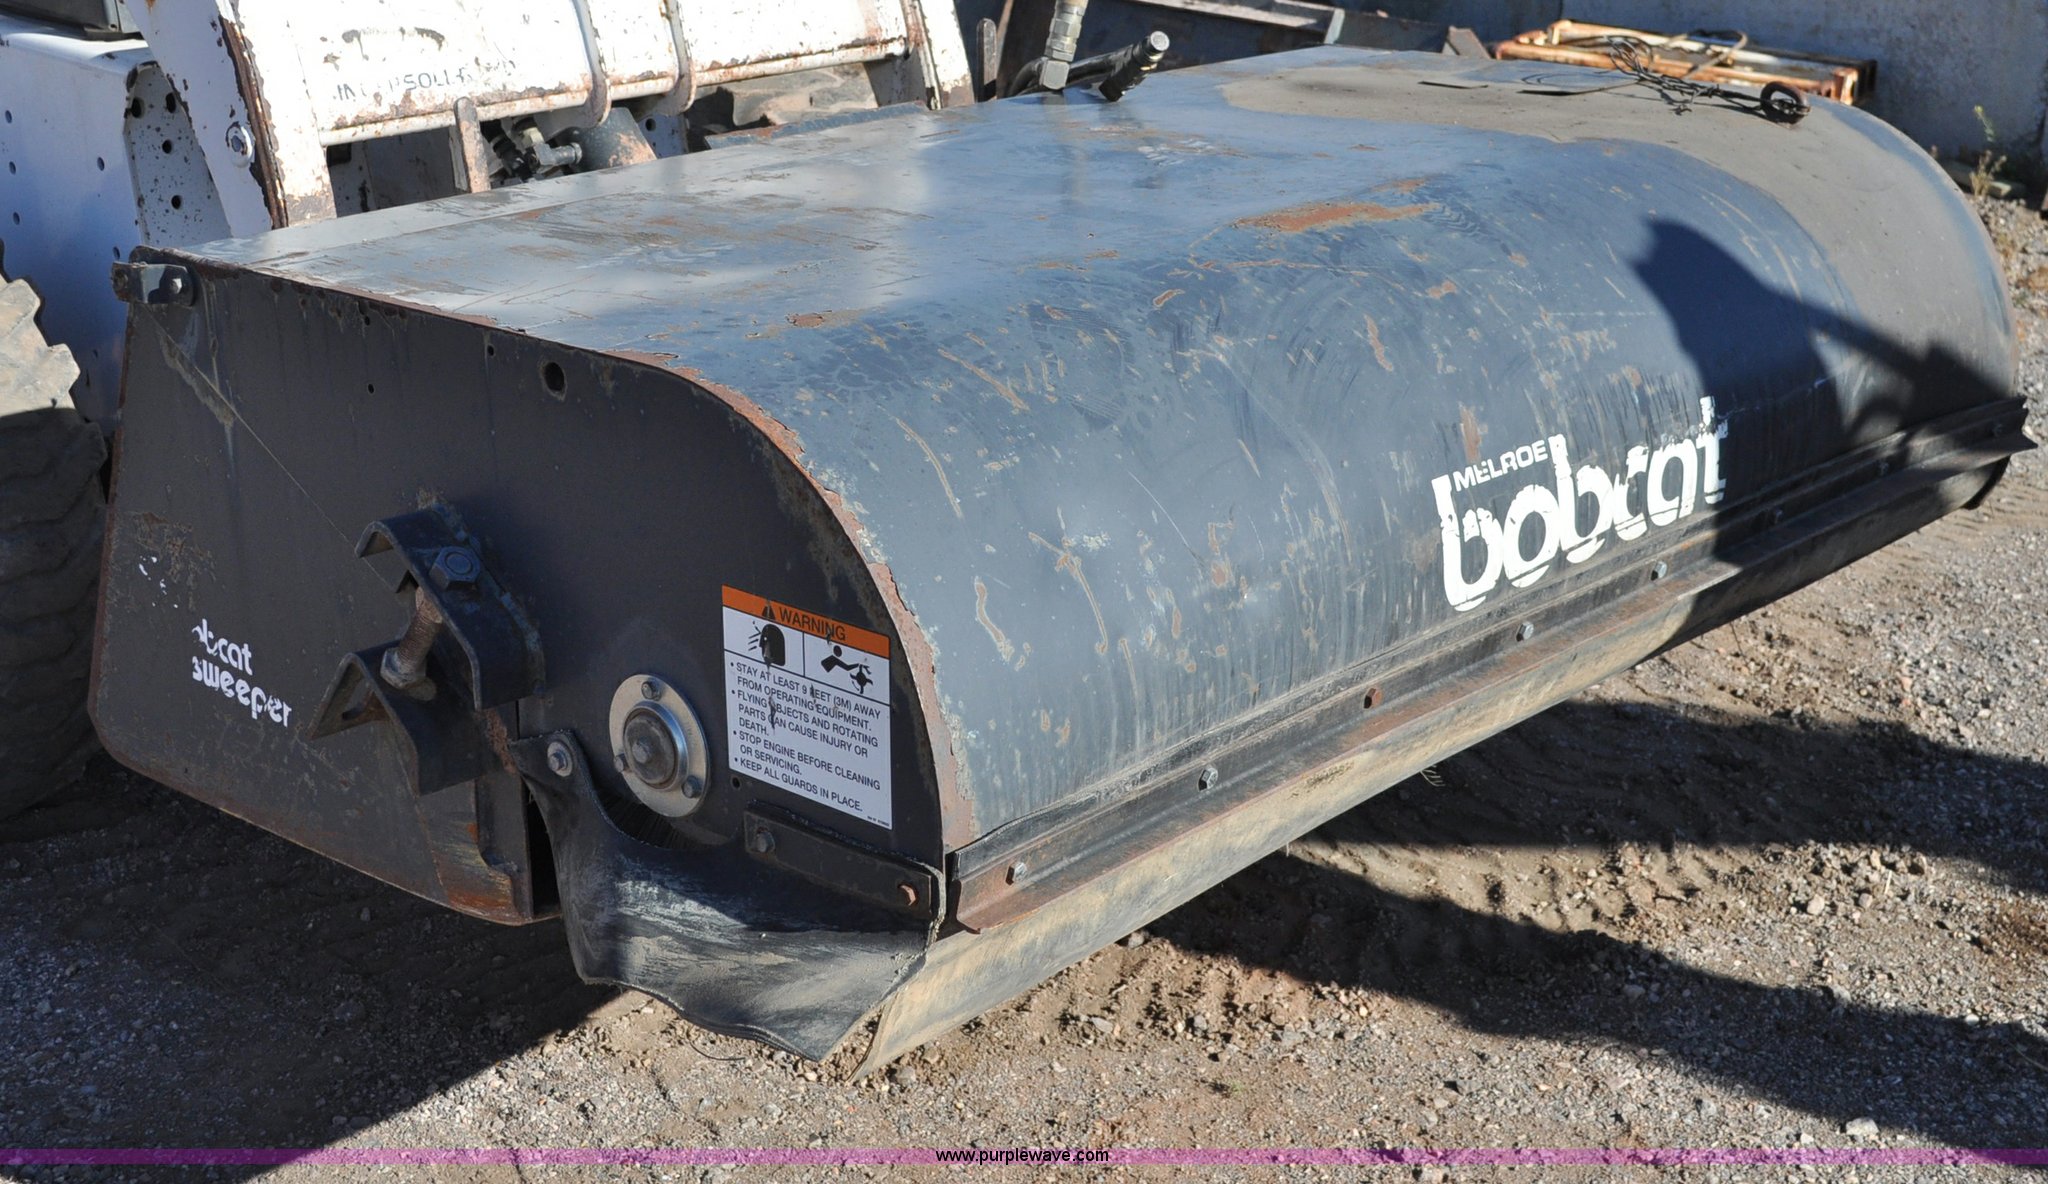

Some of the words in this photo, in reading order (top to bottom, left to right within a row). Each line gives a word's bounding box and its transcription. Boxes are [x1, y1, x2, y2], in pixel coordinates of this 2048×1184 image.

[1452, 439, 1549, 492] MELROE
[1431, 396, 1729, 612] bobcat
[779, 606, 846, 641] WARNING
[736, 662, 758, 677] STAY
[760, 670, 771, 681] AT
[773, 674, 800, 692] LEAST
[802, 684, 807, 694] 9
[810, 686, 831, 702] EET
[833, 695, 852, 712] (3M)
[853, 703, 881, 720] AWAY
[737, 676, 762, 692] FROM
[764, 685, 814, 711] OPERATING
[816, 703, 872, 731] EQUIPMENT.
[737, 689, 767, 708] FLYING
[769, 699, 810, 723] BJECTS
[811, 716, 831, 731] AND
[832, 723, 878, 748] ROTATING
[738, 703, 766, 722] PARTS
[788, 721, 818, 740] CAUSE
[820, 732, 852, 752] INJURY
[854, 745, 868, 758] OR
[739, 717, 769, 736] DEATH.
[739, 730, 762, 746] STOP
[763, 739, 796, 760] ENGINE
[797, 751, 833, 773] BEFORE
[835, 765, 881, 790] CLEANING
[740, 744, 753, 757] OR
[754, 749, 802, 776] SERVICING.
[740, 757, 762, 772] KEEP
[763, 766, 780, 780] ALL
[781, 773, 818, 795] GUARDS
[820, 787, 829, 799] IN
[831, 792, 863, 812] PLACE.
